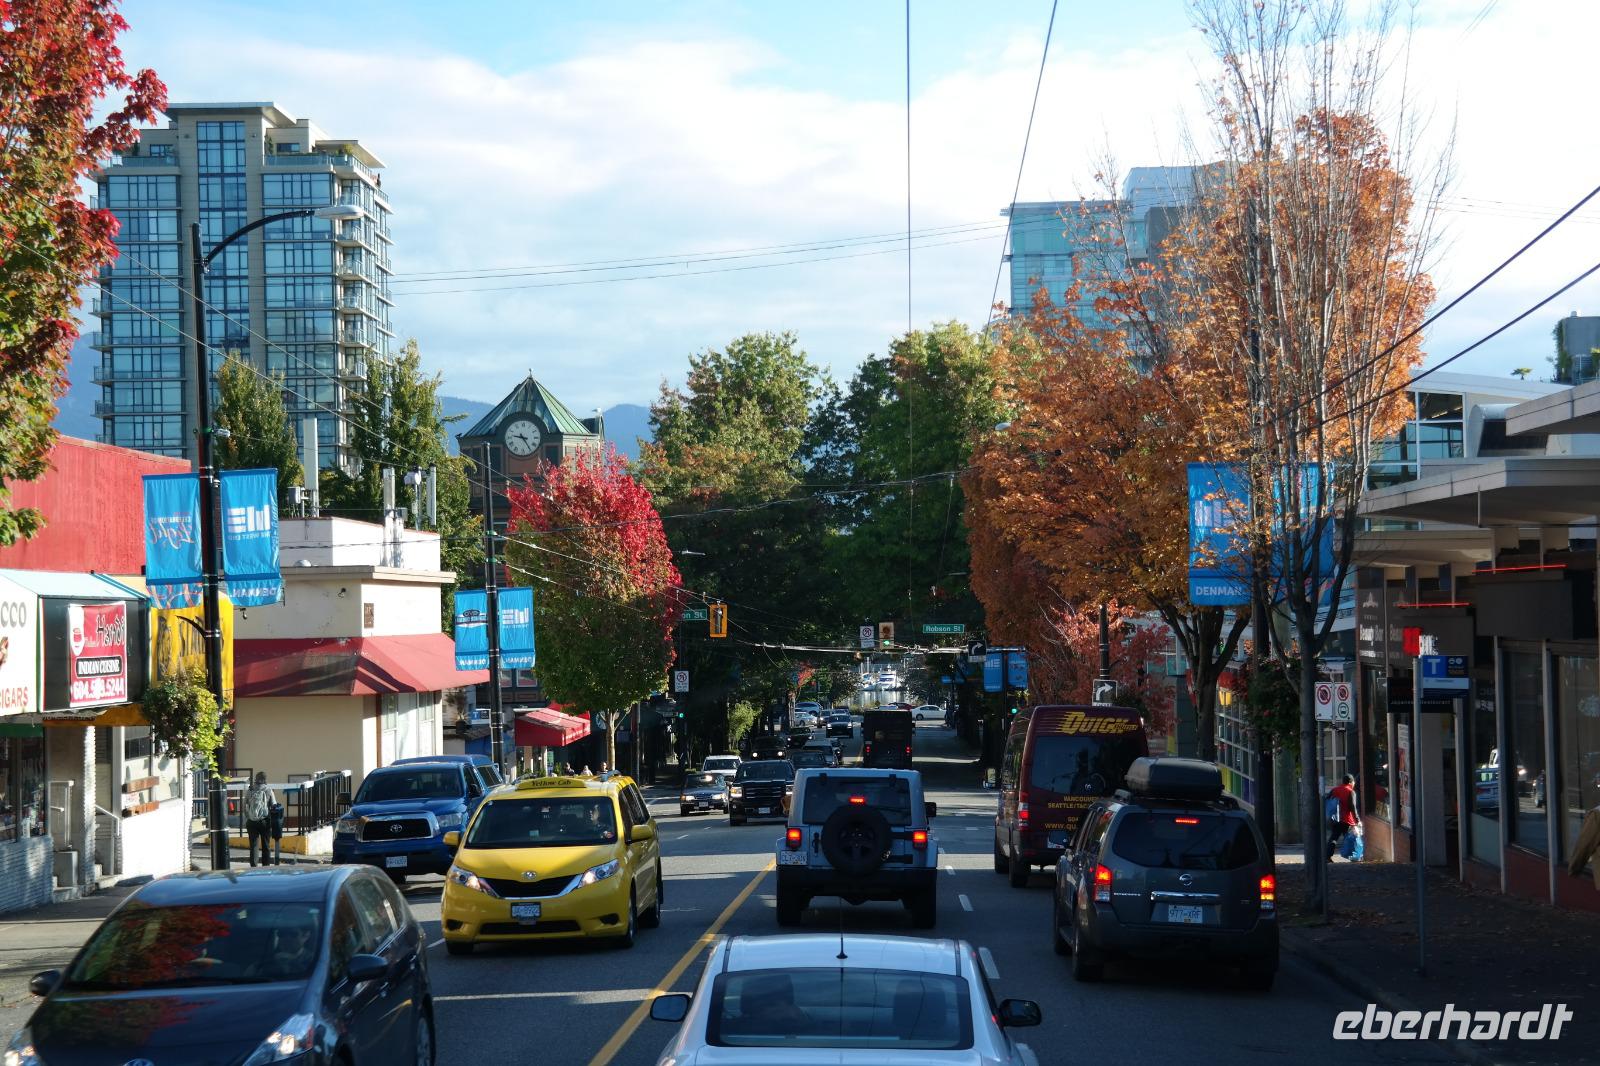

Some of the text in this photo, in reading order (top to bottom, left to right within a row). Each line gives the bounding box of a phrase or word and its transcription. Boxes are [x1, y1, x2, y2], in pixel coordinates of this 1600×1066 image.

[78, 659, 120, 675] INDIAN CUISINE
[1427, 658, 1441, 675] T
[0, 686, 28, 708] IGARS
